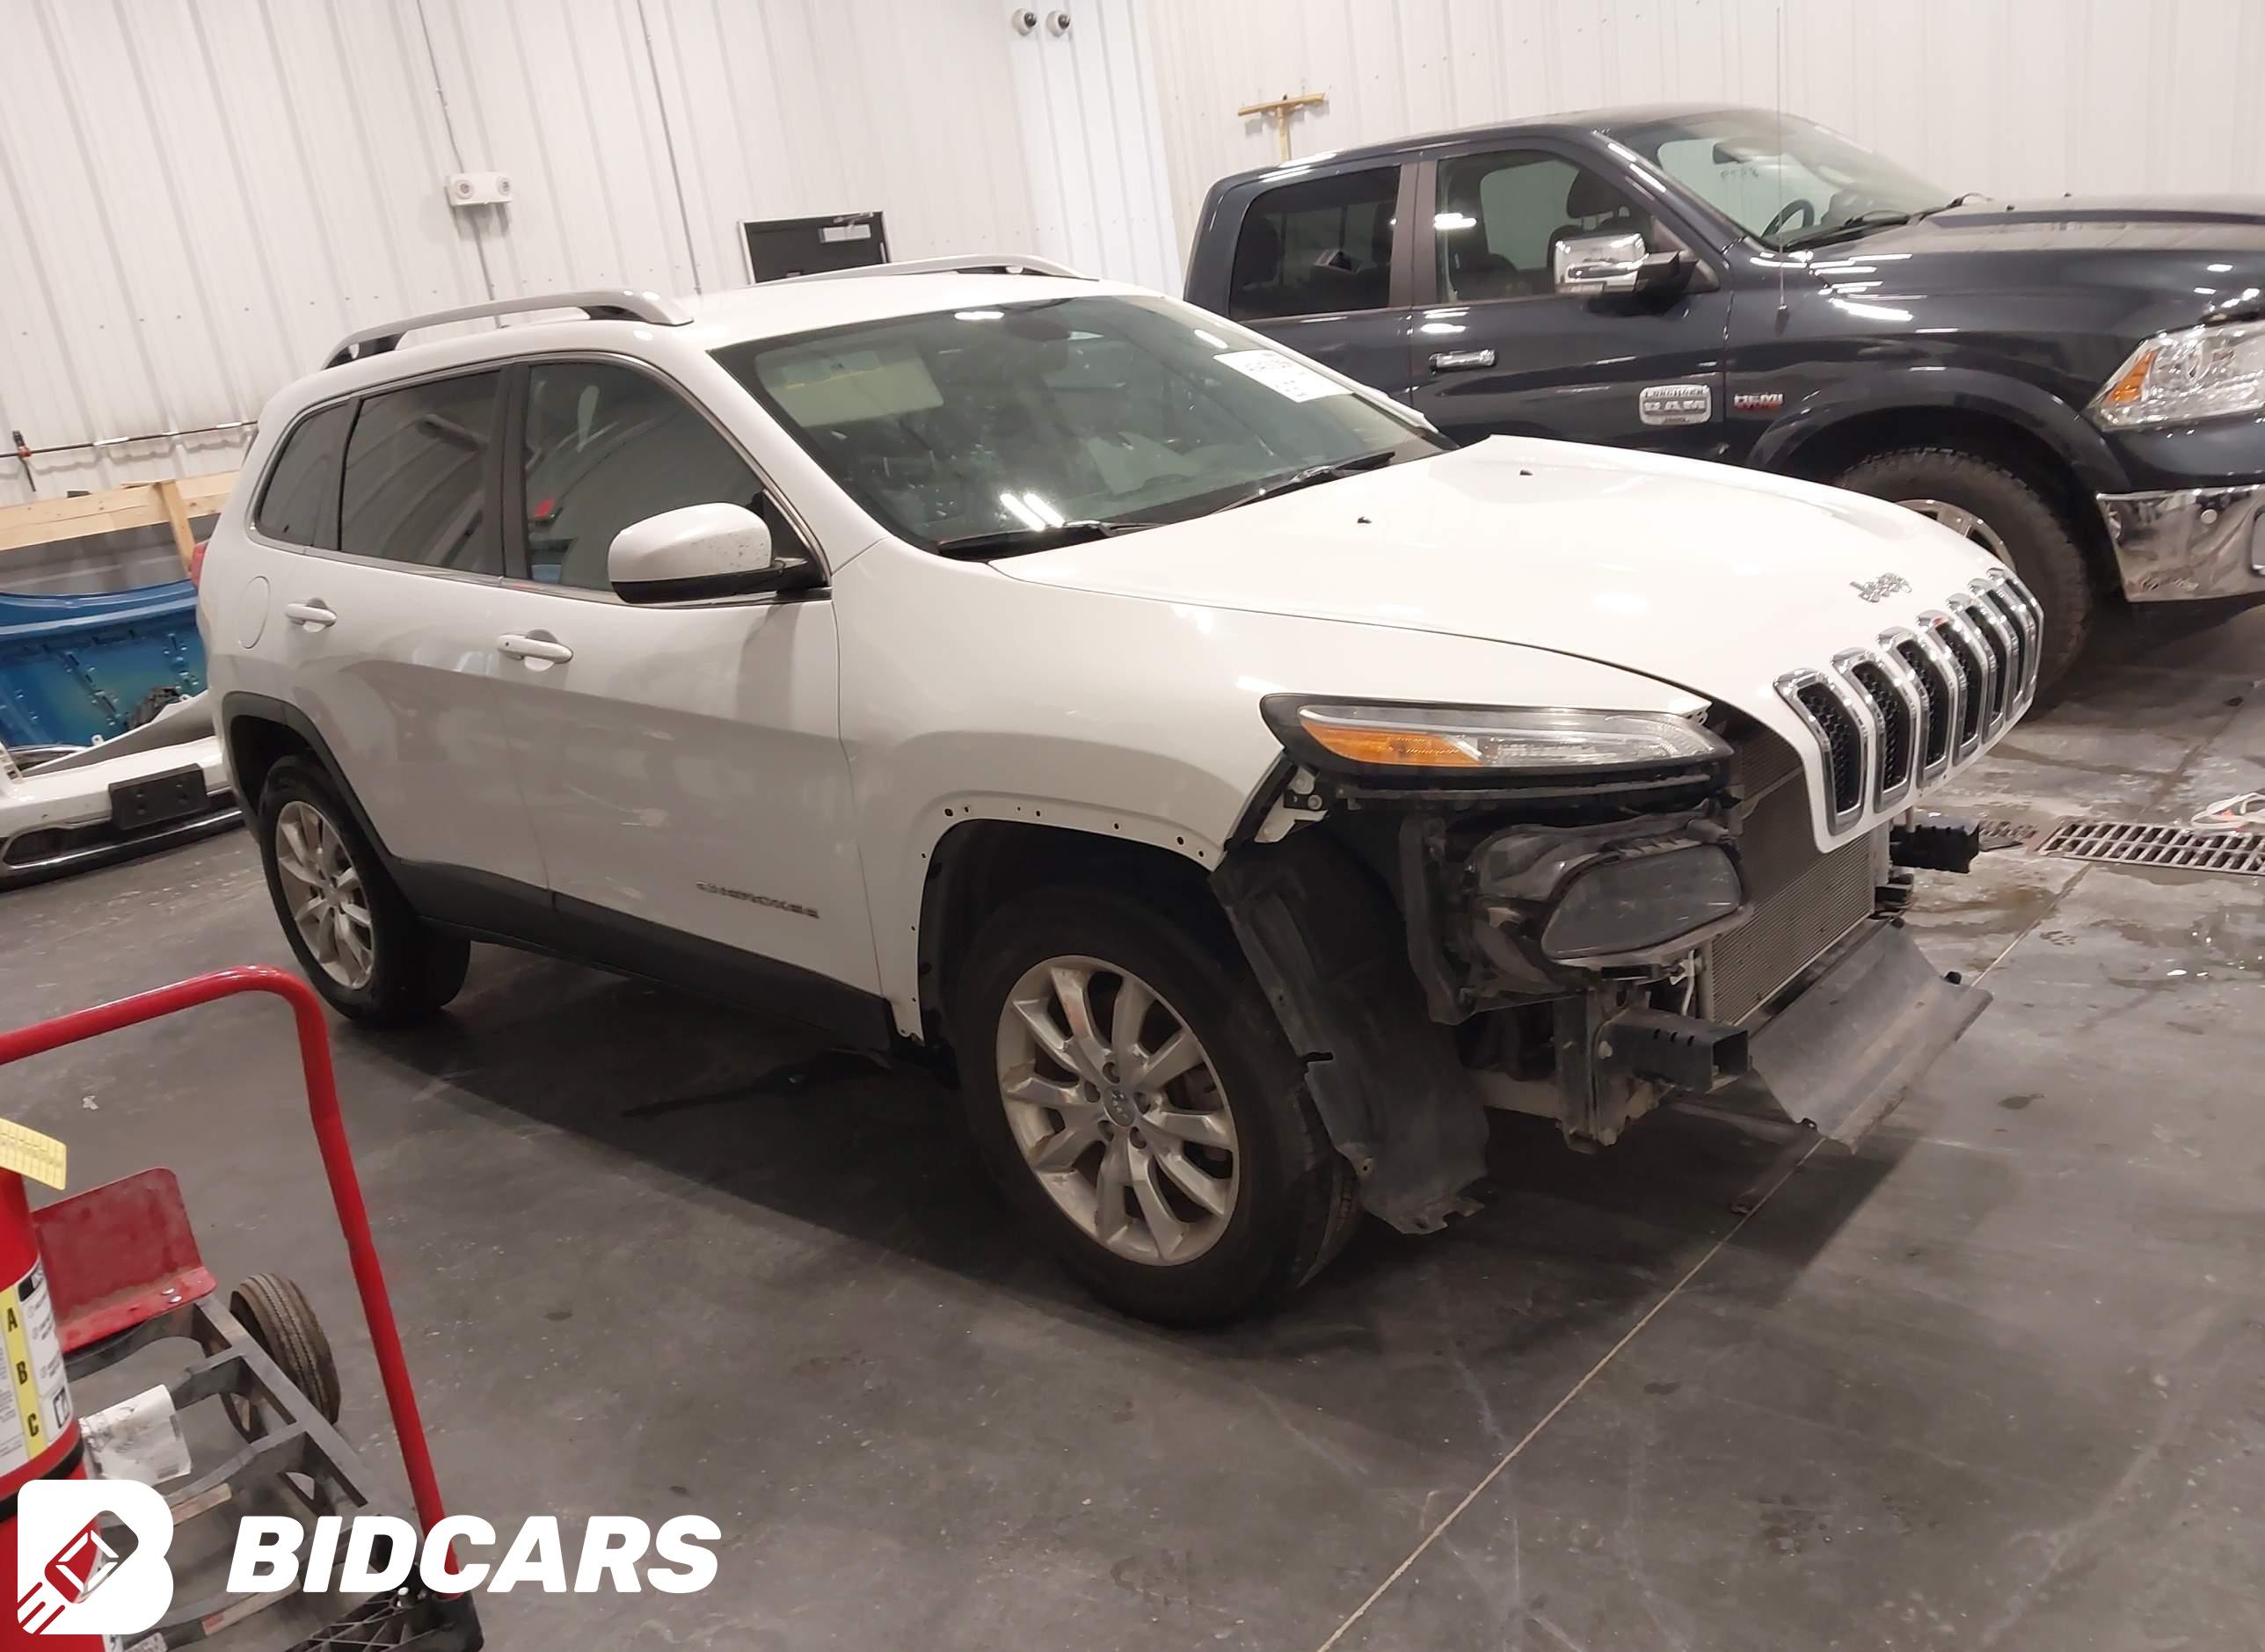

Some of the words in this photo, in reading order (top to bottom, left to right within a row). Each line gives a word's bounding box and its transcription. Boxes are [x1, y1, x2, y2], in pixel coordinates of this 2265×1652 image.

[1643, 399, 1707, 412] RAM
[1734, 393, 1783, 408] HEMI
[7, 1306, 18, 1333] A
[16, 1360, 28, 1386] B
[27, 1412, 40, 1437] C
